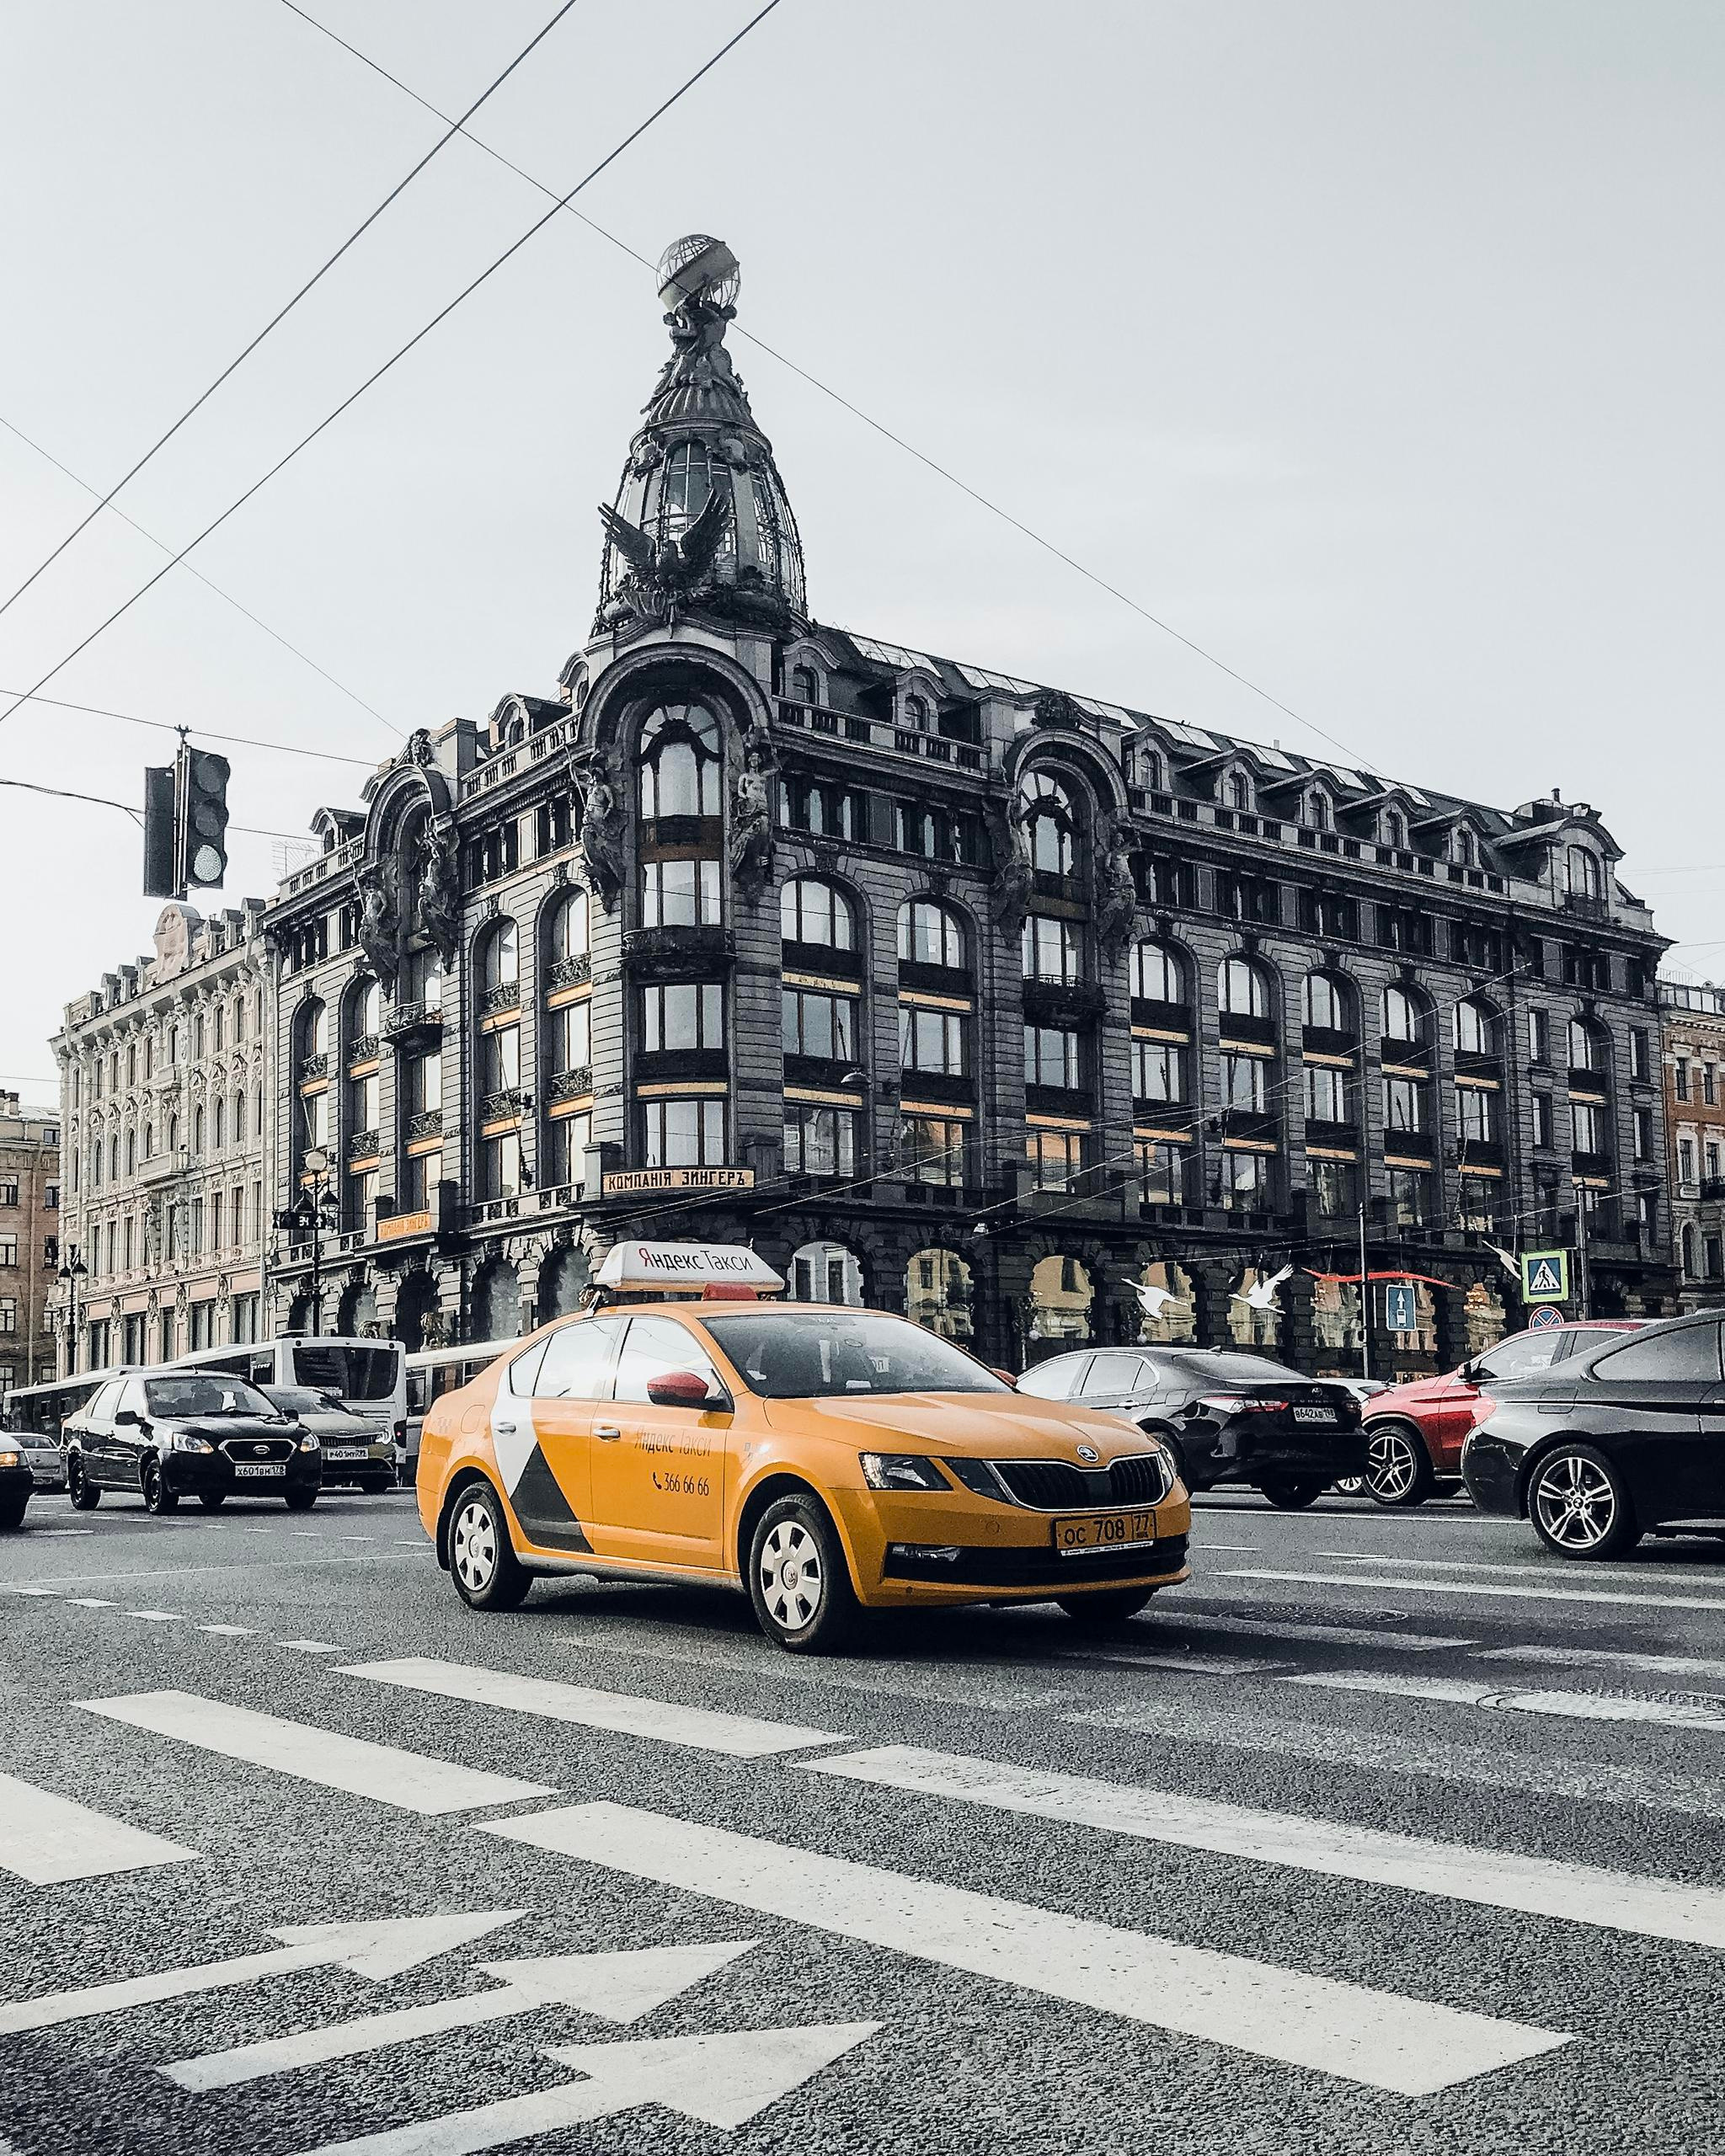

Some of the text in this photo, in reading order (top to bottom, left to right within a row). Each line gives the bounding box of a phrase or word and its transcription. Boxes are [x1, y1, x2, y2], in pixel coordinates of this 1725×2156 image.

[681, 1171, 745, 1186] ЗИНГЕРЪ
[638, 1247, 754, 1272] Яндекс Такси
[634, 1426, 712, 1457] Яндекс Такси
[664, 1473, 709, 1497] 366 66 66
[1093, 1518, 1125, 1543] 708
[1133, 1514, 1149, 1532] 77
